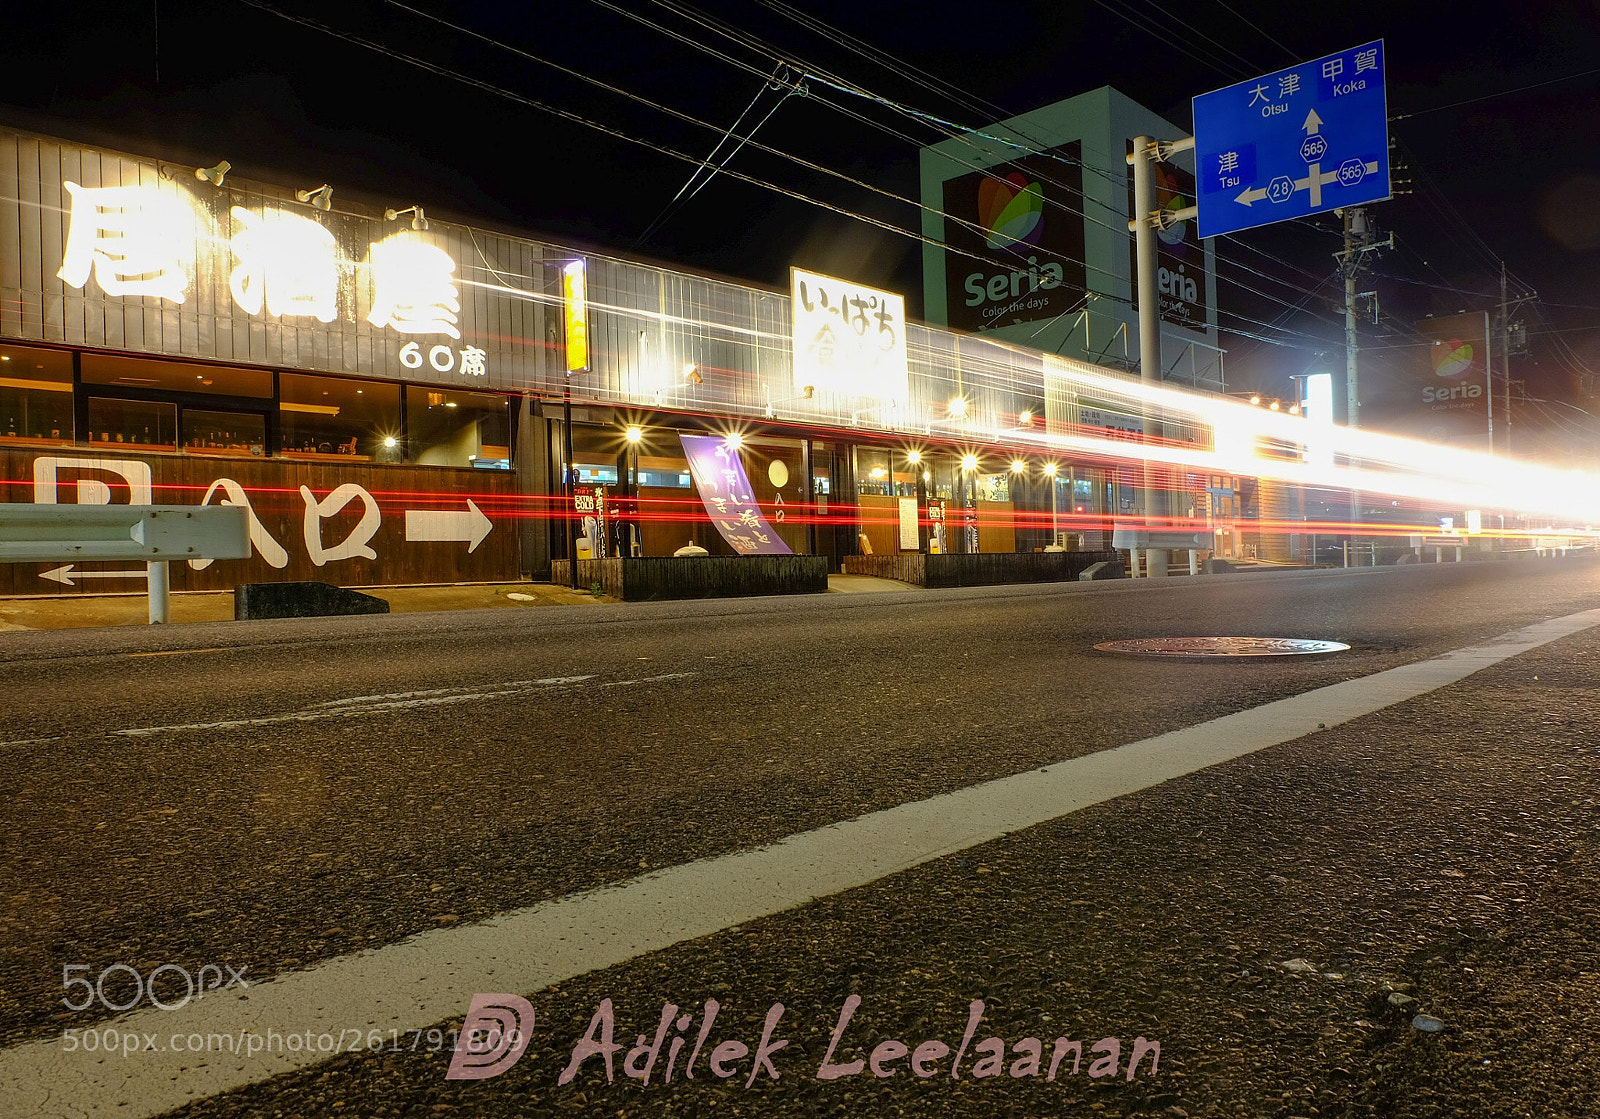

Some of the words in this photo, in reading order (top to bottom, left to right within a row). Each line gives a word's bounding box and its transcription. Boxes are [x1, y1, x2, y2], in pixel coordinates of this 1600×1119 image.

[1322, 48, 1378, 82] 甲賀
[1248, 73, 1300, 107] 大津
[1333, 78, 1366, 97] Koka
[1261, 102, 1288, 118] Otsu
[1303, 141, 1324, 157] 565
[1218, 151, 1239, 174] 津
[1341, 164, 1362, 180] 565
[1219, 176, 1240, 189] Tsu
[1272, 182, 1289, 197] 28
[964, 255, 1064, 307] Seria
[1158, 263, 1198, 303] eria
[981, 304, 1006, 318] Color
[1009, 300, 1024, 312] the
[1027, 296, 1049, 311] days
[398, 341, 487, 377] 60席
[1422, 381, 1482, 403] Seria
[575, 501, 594, 510] COLD
[187, 477, 382, 571] 入口
